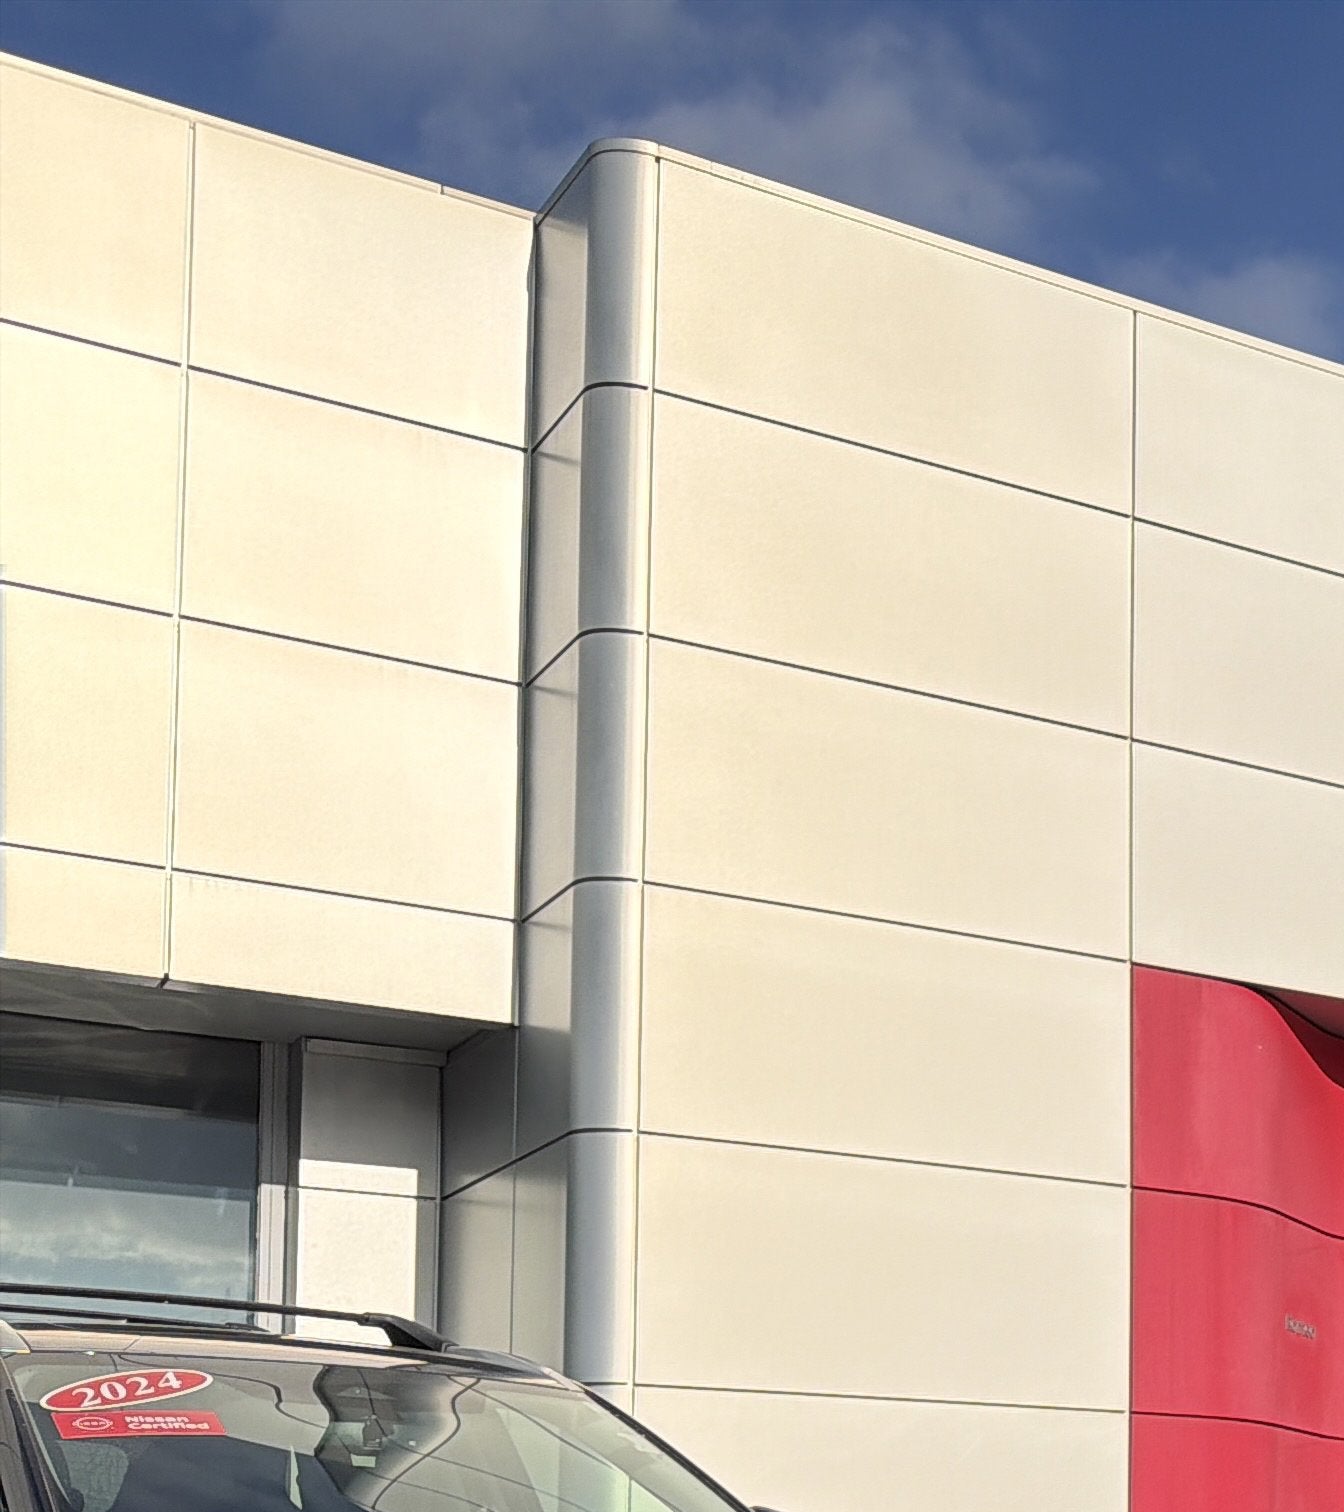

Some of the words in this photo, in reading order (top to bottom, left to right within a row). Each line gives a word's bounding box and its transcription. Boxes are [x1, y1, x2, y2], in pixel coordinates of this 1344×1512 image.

[71, 1370, 183, 1408] 2024
[124, 1415, 190, 1423] Nissan
[127, 1422, 210, 1430] Certified
